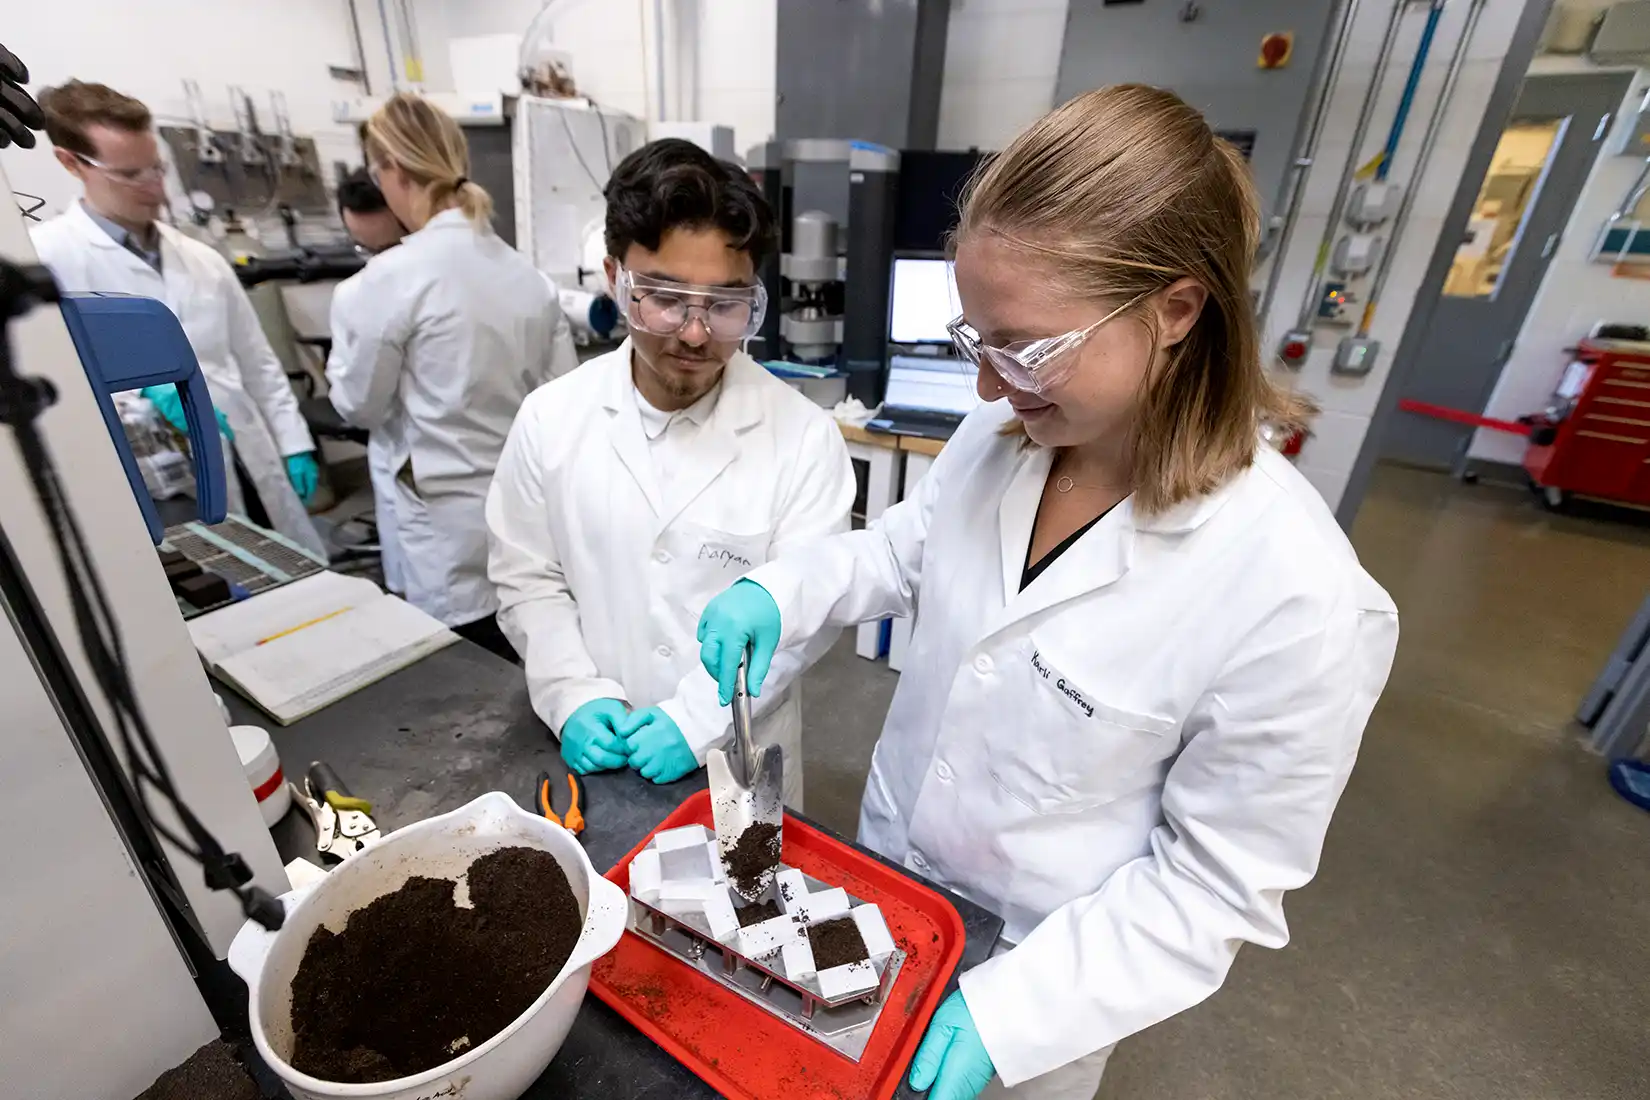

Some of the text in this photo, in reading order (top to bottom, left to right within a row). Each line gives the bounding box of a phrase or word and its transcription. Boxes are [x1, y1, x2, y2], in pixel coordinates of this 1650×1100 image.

[698, 543, 751, 569] Aaryan
[1031, 650, 1094, 718] Karli Gaffrey
